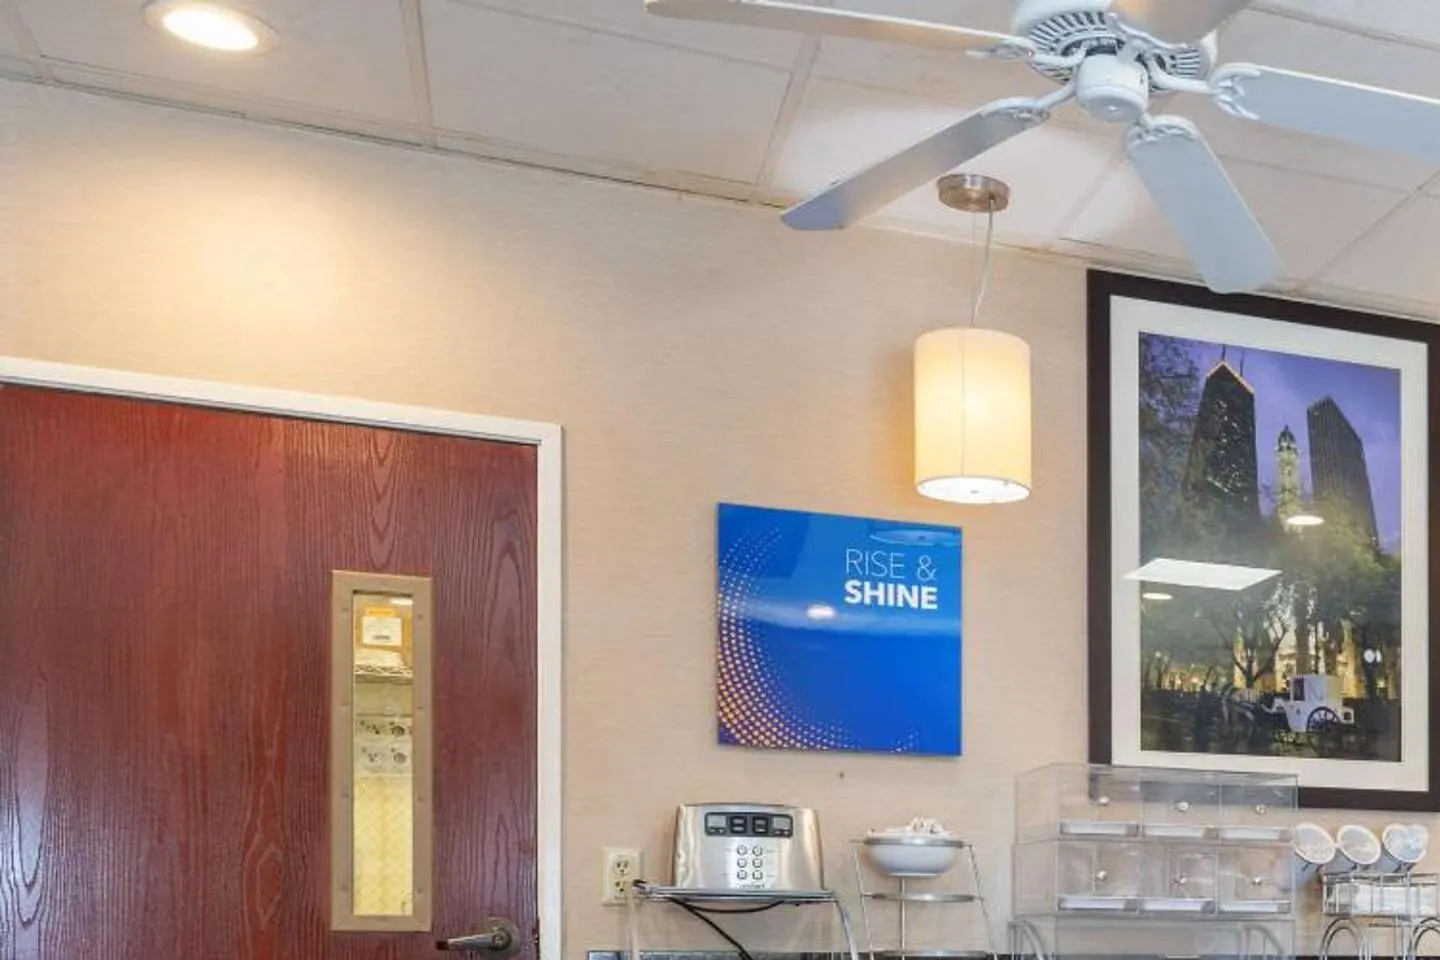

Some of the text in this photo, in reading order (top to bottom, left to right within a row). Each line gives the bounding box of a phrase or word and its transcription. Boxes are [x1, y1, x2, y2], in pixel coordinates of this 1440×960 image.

[846, 548, 937, 581] RISE &
[844, 579, 938, 610] SHINE
